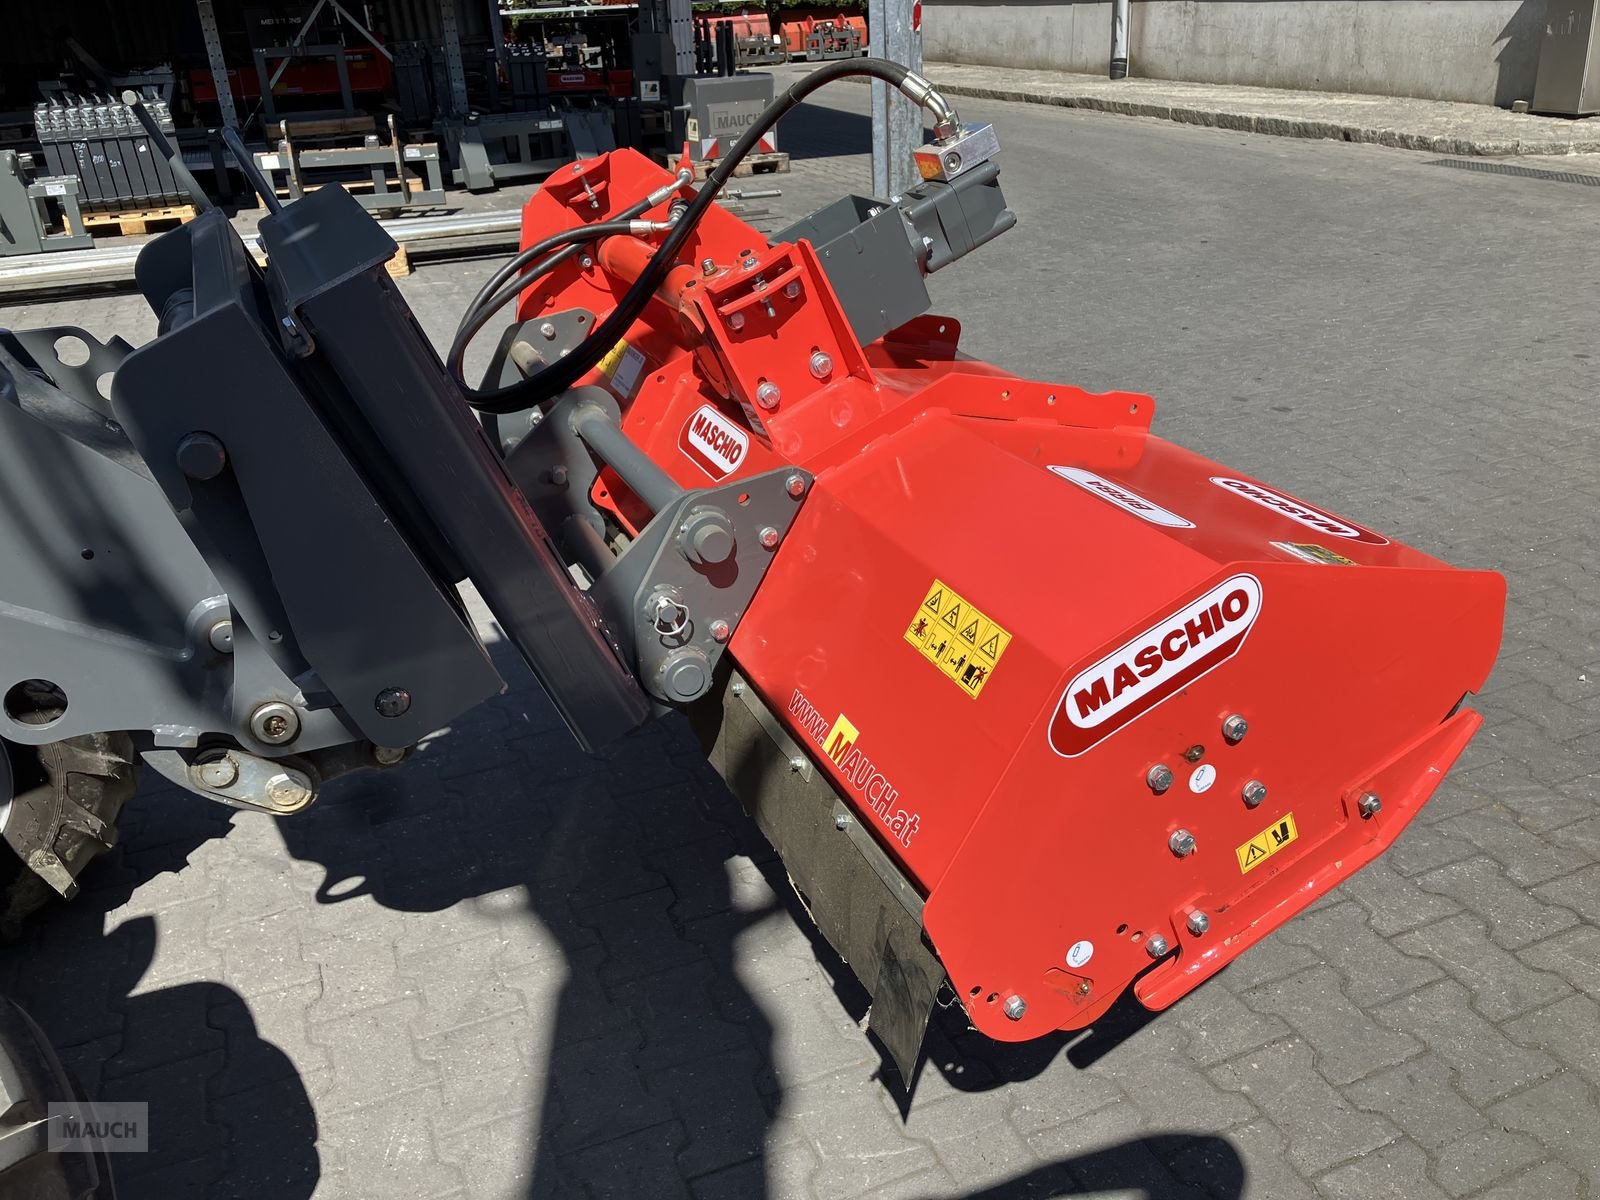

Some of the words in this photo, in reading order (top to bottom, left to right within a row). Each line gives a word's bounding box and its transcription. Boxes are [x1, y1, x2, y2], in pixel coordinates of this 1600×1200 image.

[692, 414, 743, 465] MASCHIO
[1222, 480, 1352, 535] MASCHIO
[1073, 588, 1249, 720] MASCHIO
[788, 688, 921, 848] www.MAUCH.at
